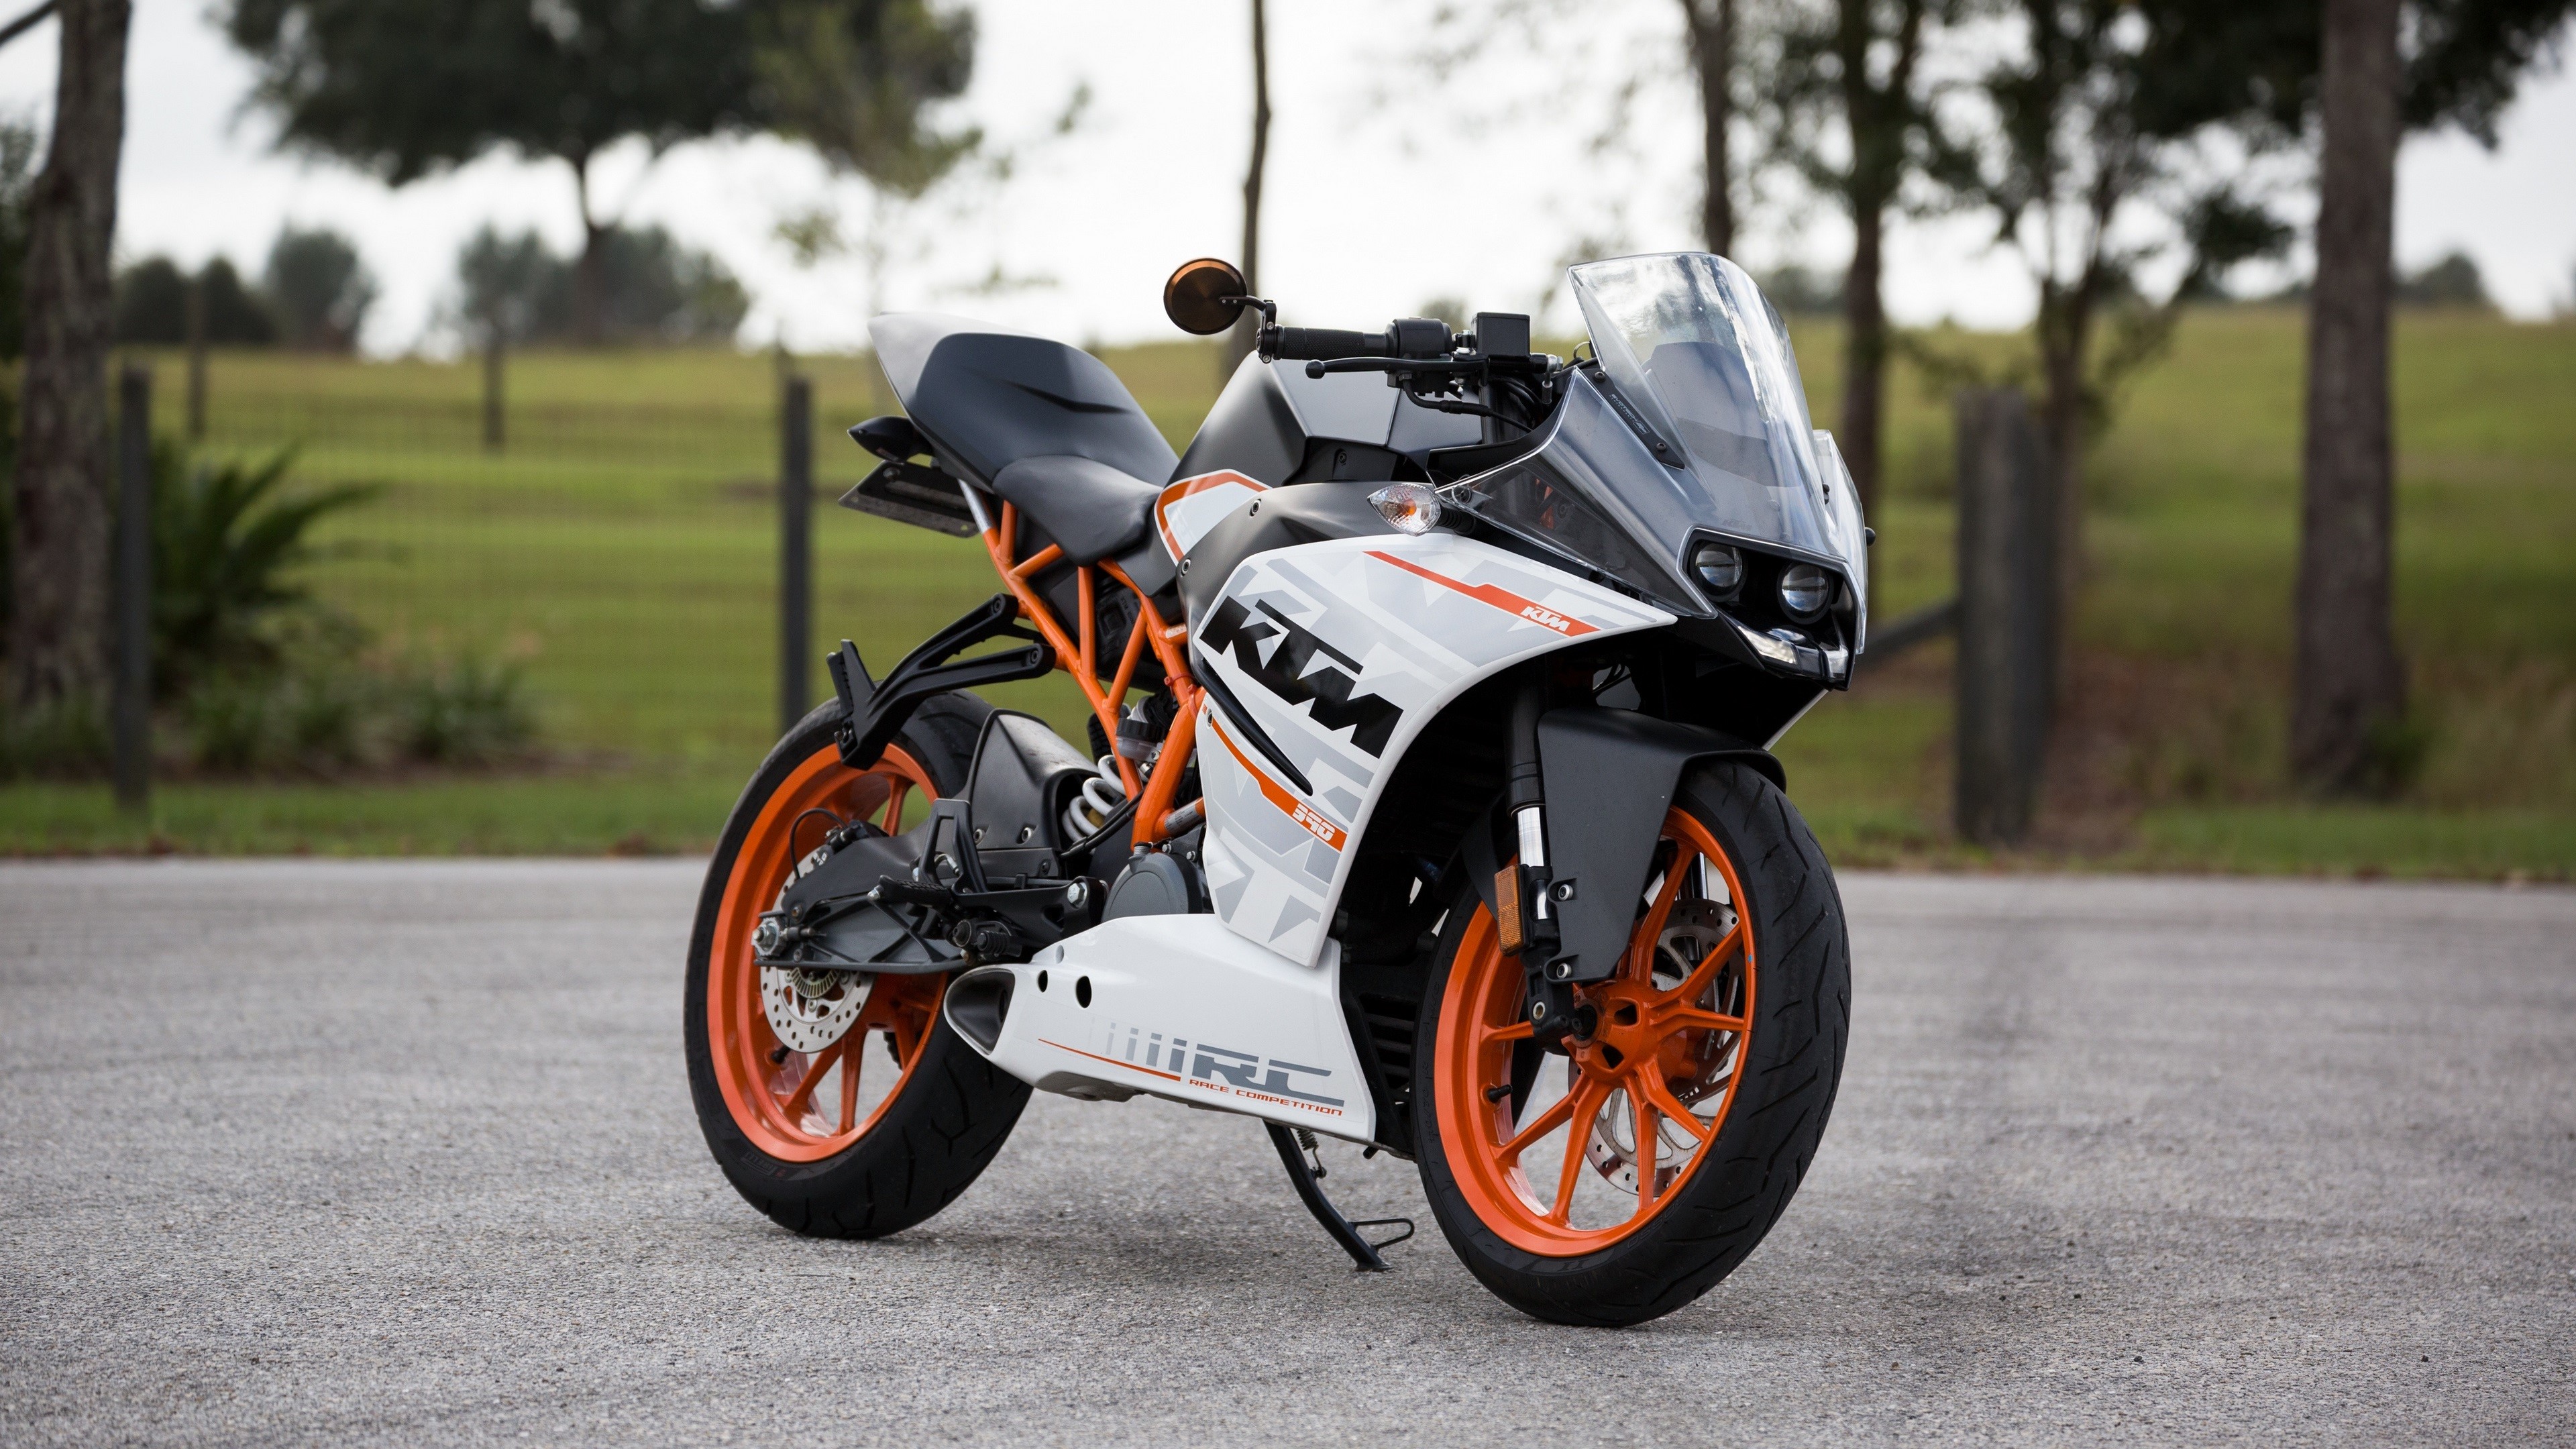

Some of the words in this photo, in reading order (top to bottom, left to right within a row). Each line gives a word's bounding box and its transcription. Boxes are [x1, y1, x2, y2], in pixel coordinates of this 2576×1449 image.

[1520, 606, 1570, 632] KTM
[1199, 595, 1404, 759] KTM
[1292, 802, 1335, 841] 390
[1189, 1079, 1229, 1093] RACE
[1236, 1089, 1342, 1116] COMPETITION
